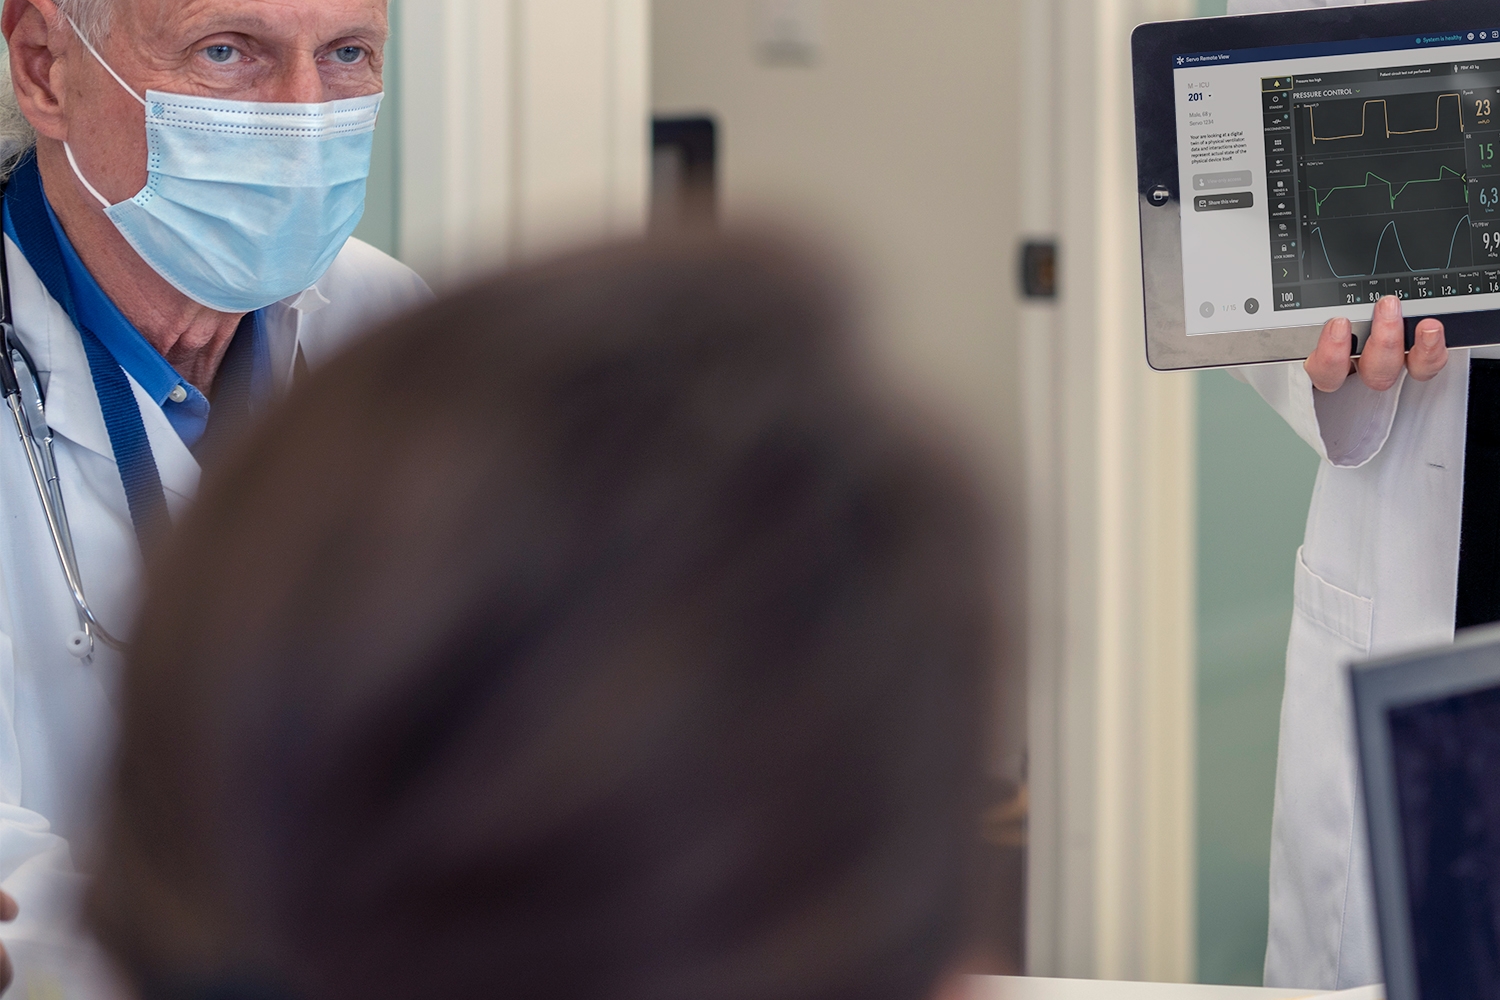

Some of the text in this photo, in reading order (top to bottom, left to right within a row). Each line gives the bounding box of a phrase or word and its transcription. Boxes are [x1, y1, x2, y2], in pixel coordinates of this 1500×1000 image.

[1188, 93, 1203, 102] 201
[1293, 88, 1352, 99] PRESSURE CONTROL
[1475, 99, 1491, 116] 23
[1479, 144, 1494, 160] 15
[1480, 187, 1499, 207] 6,3
[1482, 232, 1500, 252] 9,9
[1441, 286, 1452, 295] 1:2
[1468, 284, 1472, 293] 5
[1489, 282, 1499, 292] 1,6
[1281, 292, 1293, 302] 100
[1369, 292, 1380, 302] 8,0
[1395, 290, 1403, 299] 15
[1418, 288, 1427, 297] 15
[1347, 294, 1355, 303] 21
